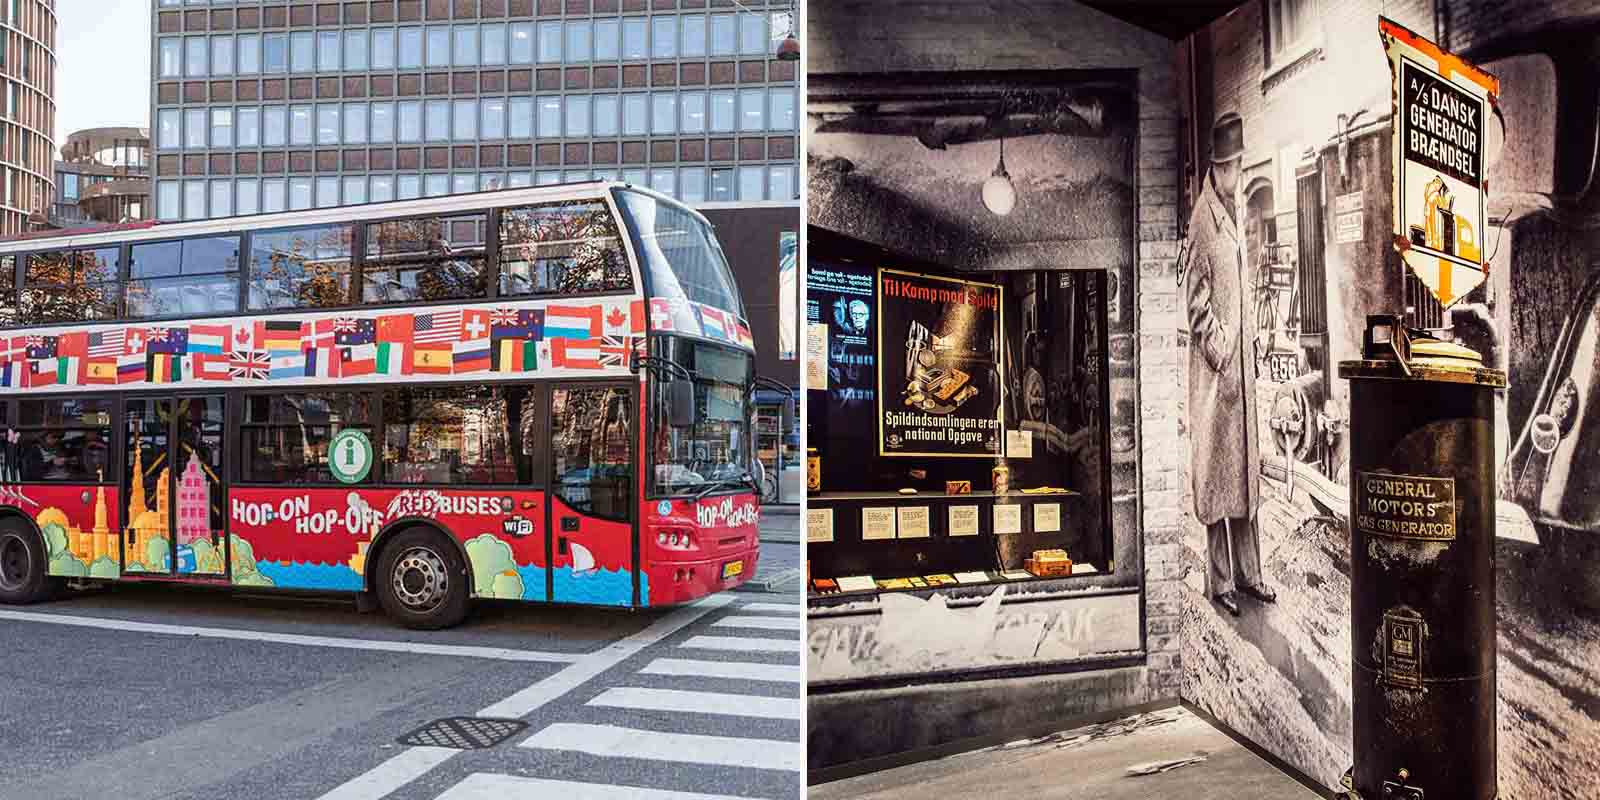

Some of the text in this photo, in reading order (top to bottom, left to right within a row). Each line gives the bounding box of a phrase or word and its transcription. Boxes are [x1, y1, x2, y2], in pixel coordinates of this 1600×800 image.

[1431, 87, 1476, 130] DANSK
[1410, 103, 1477, 153] GENERATOR
[1410, 128, 1476, 177] BRÆNDSEL
[883, 277, 899, 297] Til
[902, 281, 937, 304] Kamp
[939, 287, 965, 305] mod
[967, 286, 998, 311] Spild
[885, 410, 976, 431] Spildindsamlingen
[905, 427, 946, 441] national
[948, 428, 983, 445] Opgave
[1366, 480, 1436, 498] GENERAL
[232, 495, 310, 526] HOP-ON
[296, 503, 384, 534] HOP-OFF
[440, 496, 501, 515] BUSES
[696, 496, 733, 528] HOP-ON
[1367, 497, 1436, 518] MOTORS
[1358, 515, 1454, 537] GAS GENERATOR
[1393, 624, 1411, 641] GM
